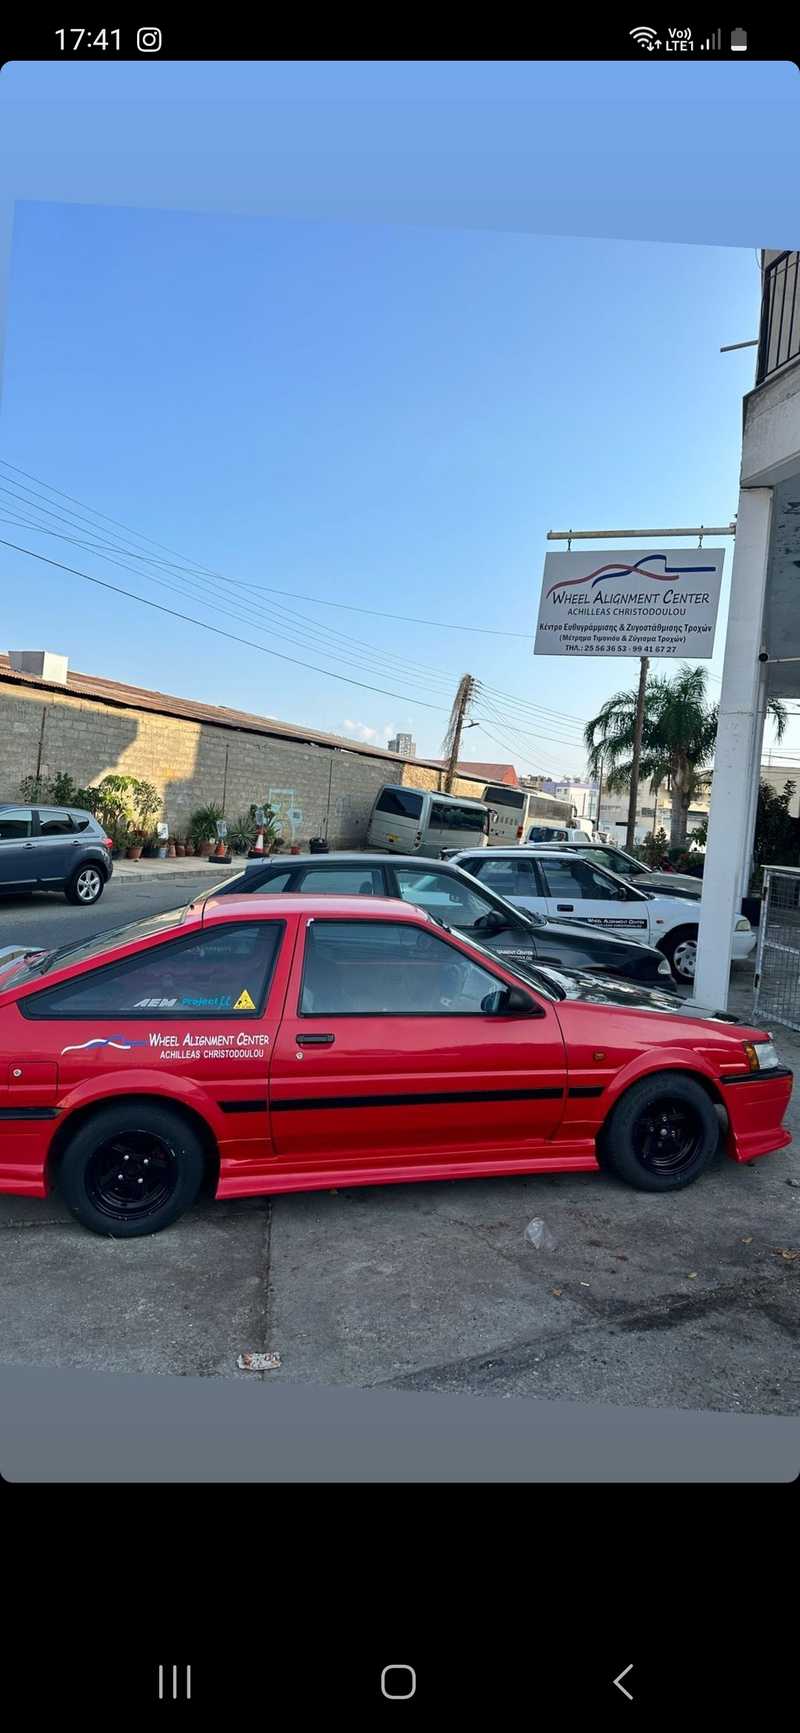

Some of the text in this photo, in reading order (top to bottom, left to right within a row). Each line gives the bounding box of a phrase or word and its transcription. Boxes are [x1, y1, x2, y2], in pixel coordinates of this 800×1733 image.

[552, 589, 710, 604] WHEEL ALIGNMENT CENTER
[568, 608, 687, 616] ACHILLEAS CHRISTODOULOU
[540, 623, 563, 632] Κέντρο
[685, 624, 712, 634] Τροχών
[584, 645, 594, 653] 25
[595, 645, 605, 653] 56
[606, 645, 616, 653] 36
[617, 645, 627, 653] 53
[633, 645, 643, 653] 99
[644, 645, 653, 653] 41
[655, 645, 665, 653] 67
[666, 645, 677, 653] 27
[133, 999, 178, 1007] AEM
[149, 1033, 270, 1047] WHEEL ALIGNMENT CENTER
[160, 1049, 264, 1059] ACHILLEAS CHRISTODOULOU
